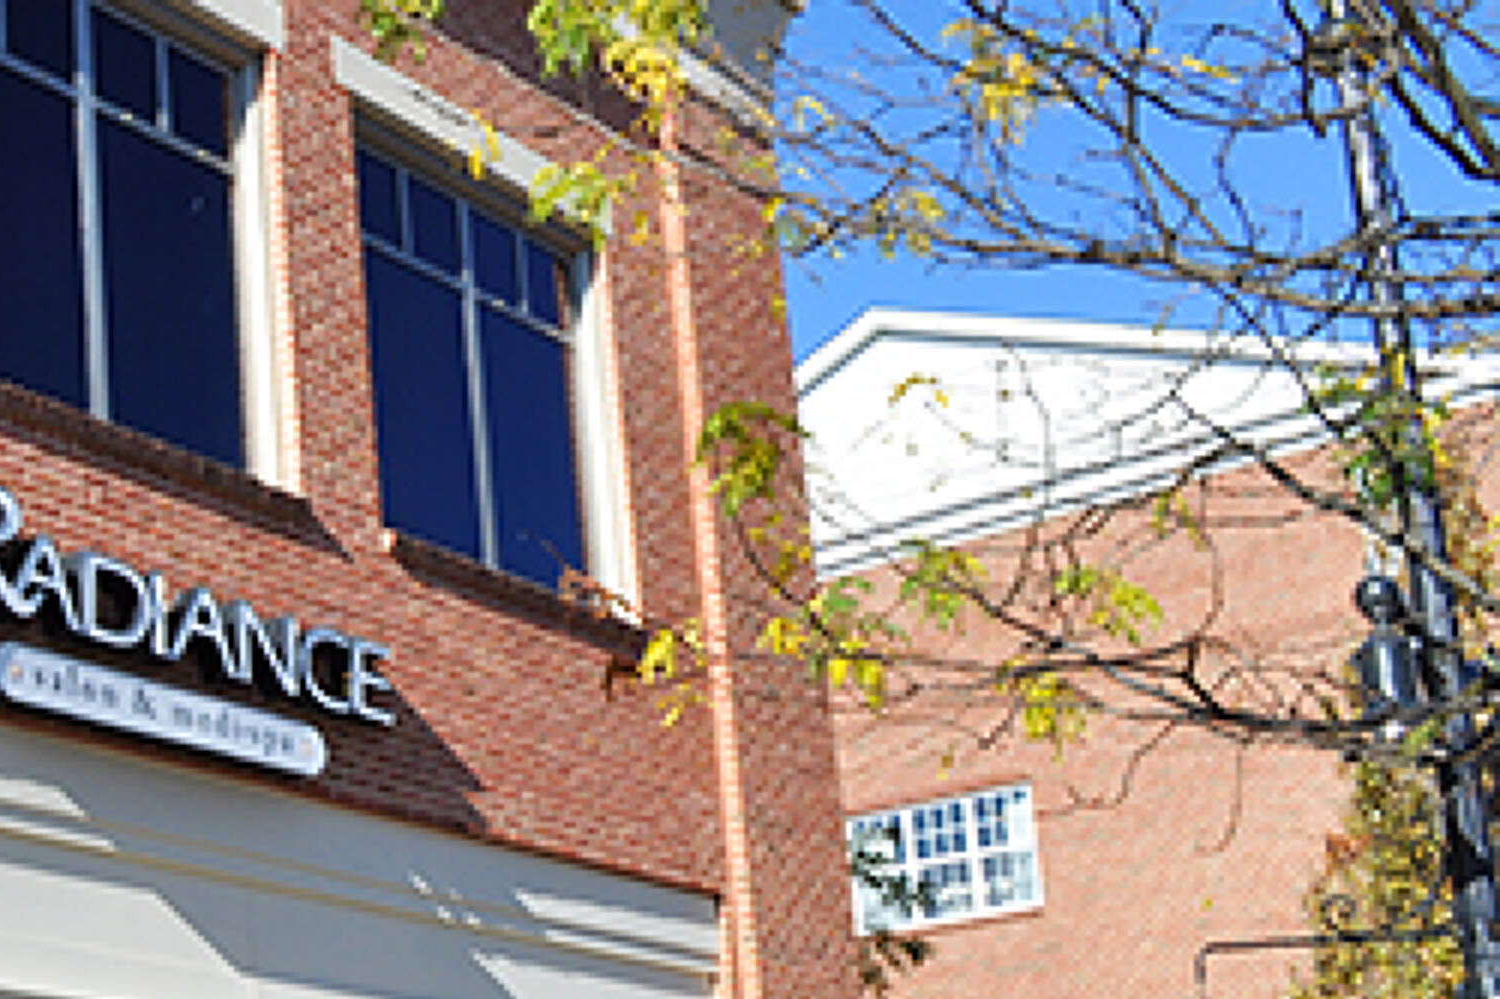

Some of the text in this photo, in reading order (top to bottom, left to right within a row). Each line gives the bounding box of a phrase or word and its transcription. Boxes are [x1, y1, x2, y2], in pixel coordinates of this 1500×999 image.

[31, 660, 297, 756] salon & medispa
